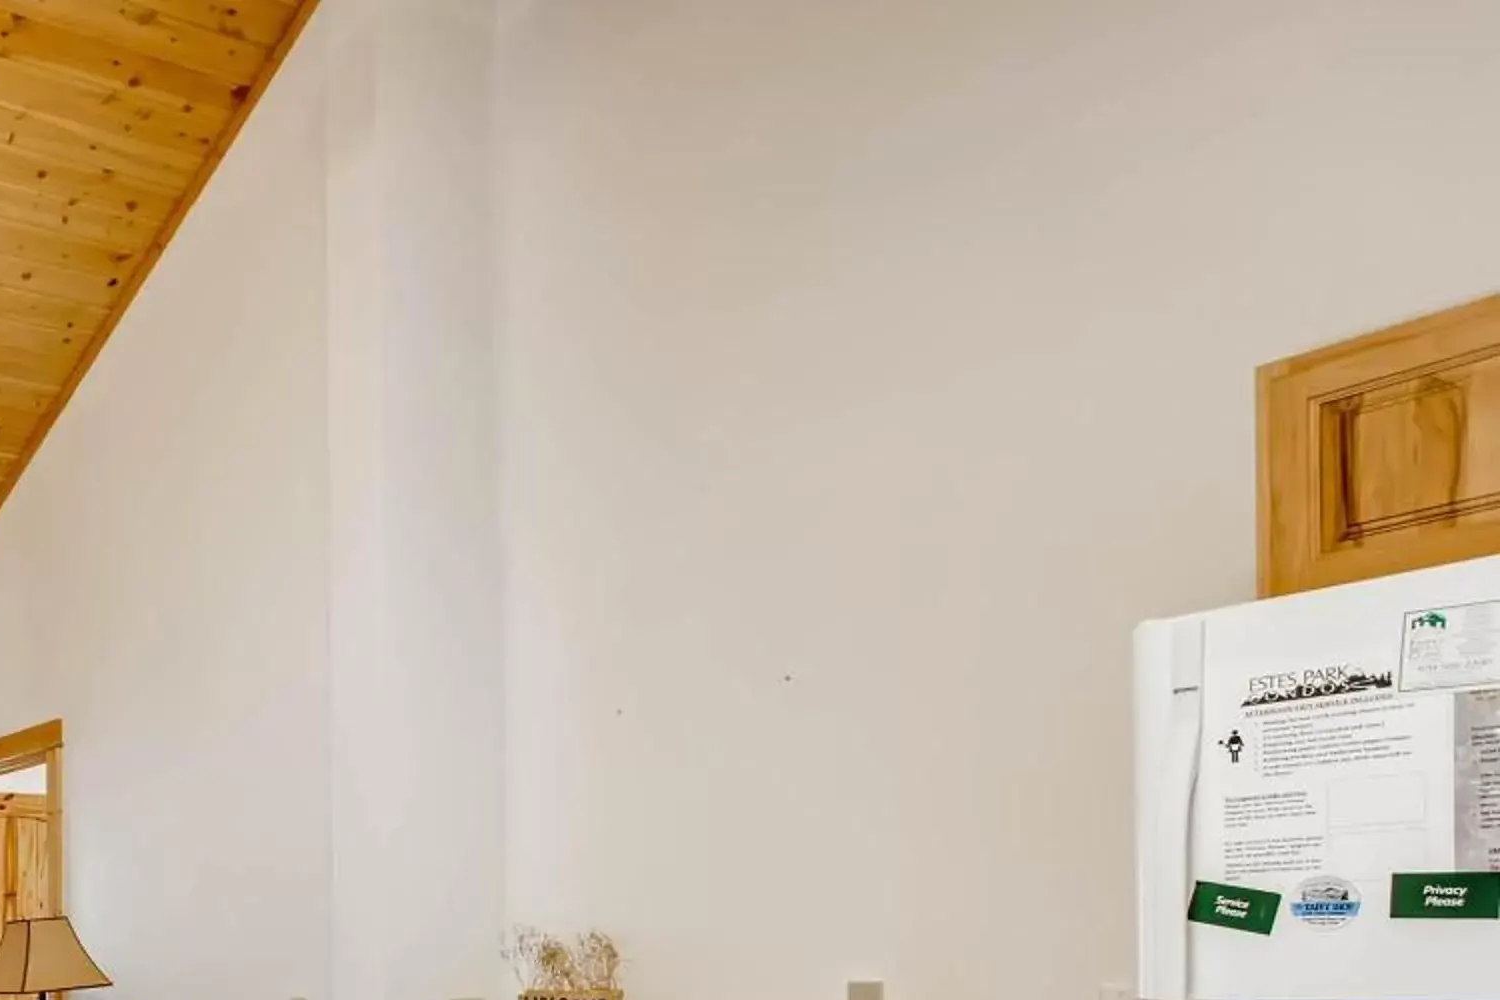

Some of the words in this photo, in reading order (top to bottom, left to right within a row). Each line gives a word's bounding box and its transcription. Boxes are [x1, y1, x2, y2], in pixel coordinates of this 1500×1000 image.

[1248, 671, 1298, 692] ESTES
[1303, 662, 1349, 684] PARK
[1423, 884, 1468, 897] Privacy
[1213, 895, 1250, 909] Service
[1424, 896, 1466, 908] Please
[1215, 906, 1248, 918] Please
